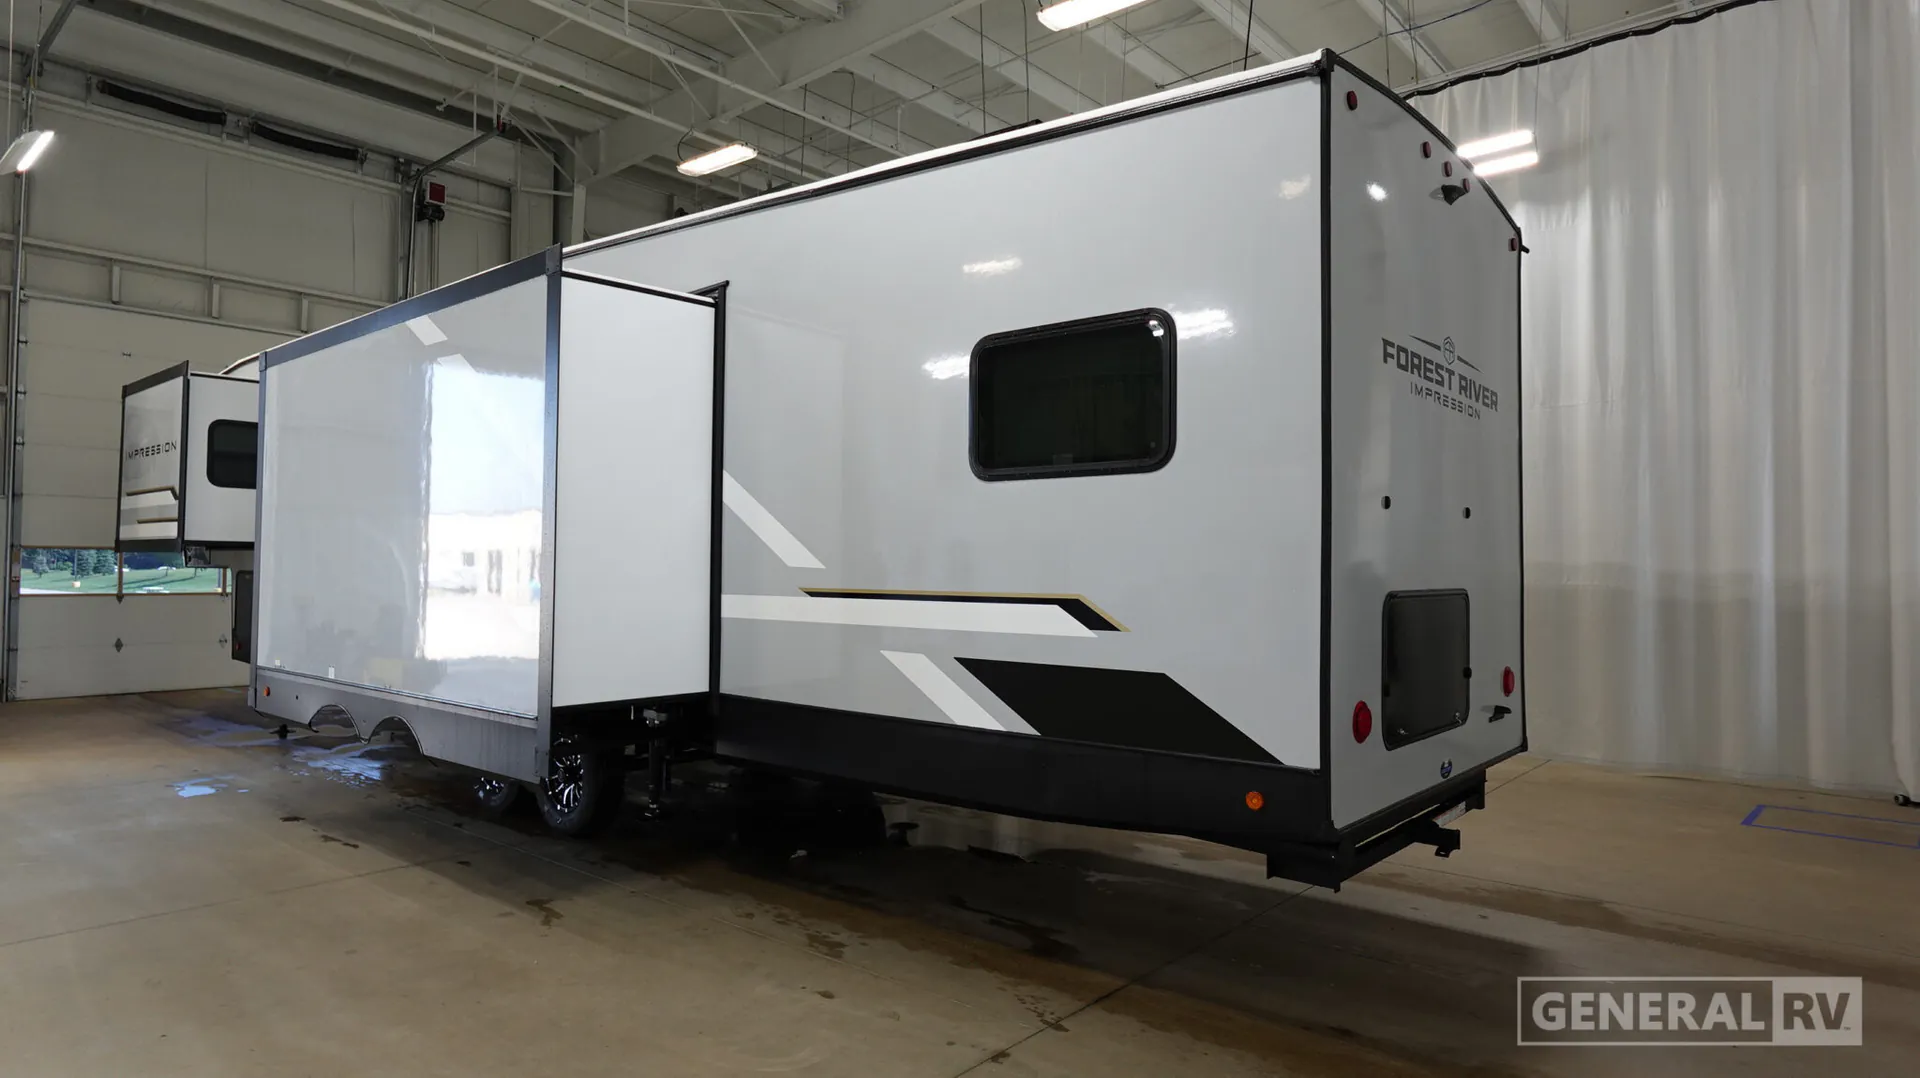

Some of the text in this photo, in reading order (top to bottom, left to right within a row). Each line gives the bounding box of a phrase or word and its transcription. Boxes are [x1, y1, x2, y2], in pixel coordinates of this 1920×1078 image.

[1381, 337, 1499, 412] FOREST RIVER
[1410, 381, 1481, 420] IMPRESSION
[125, 440, 177, 461] IMPRESSION
